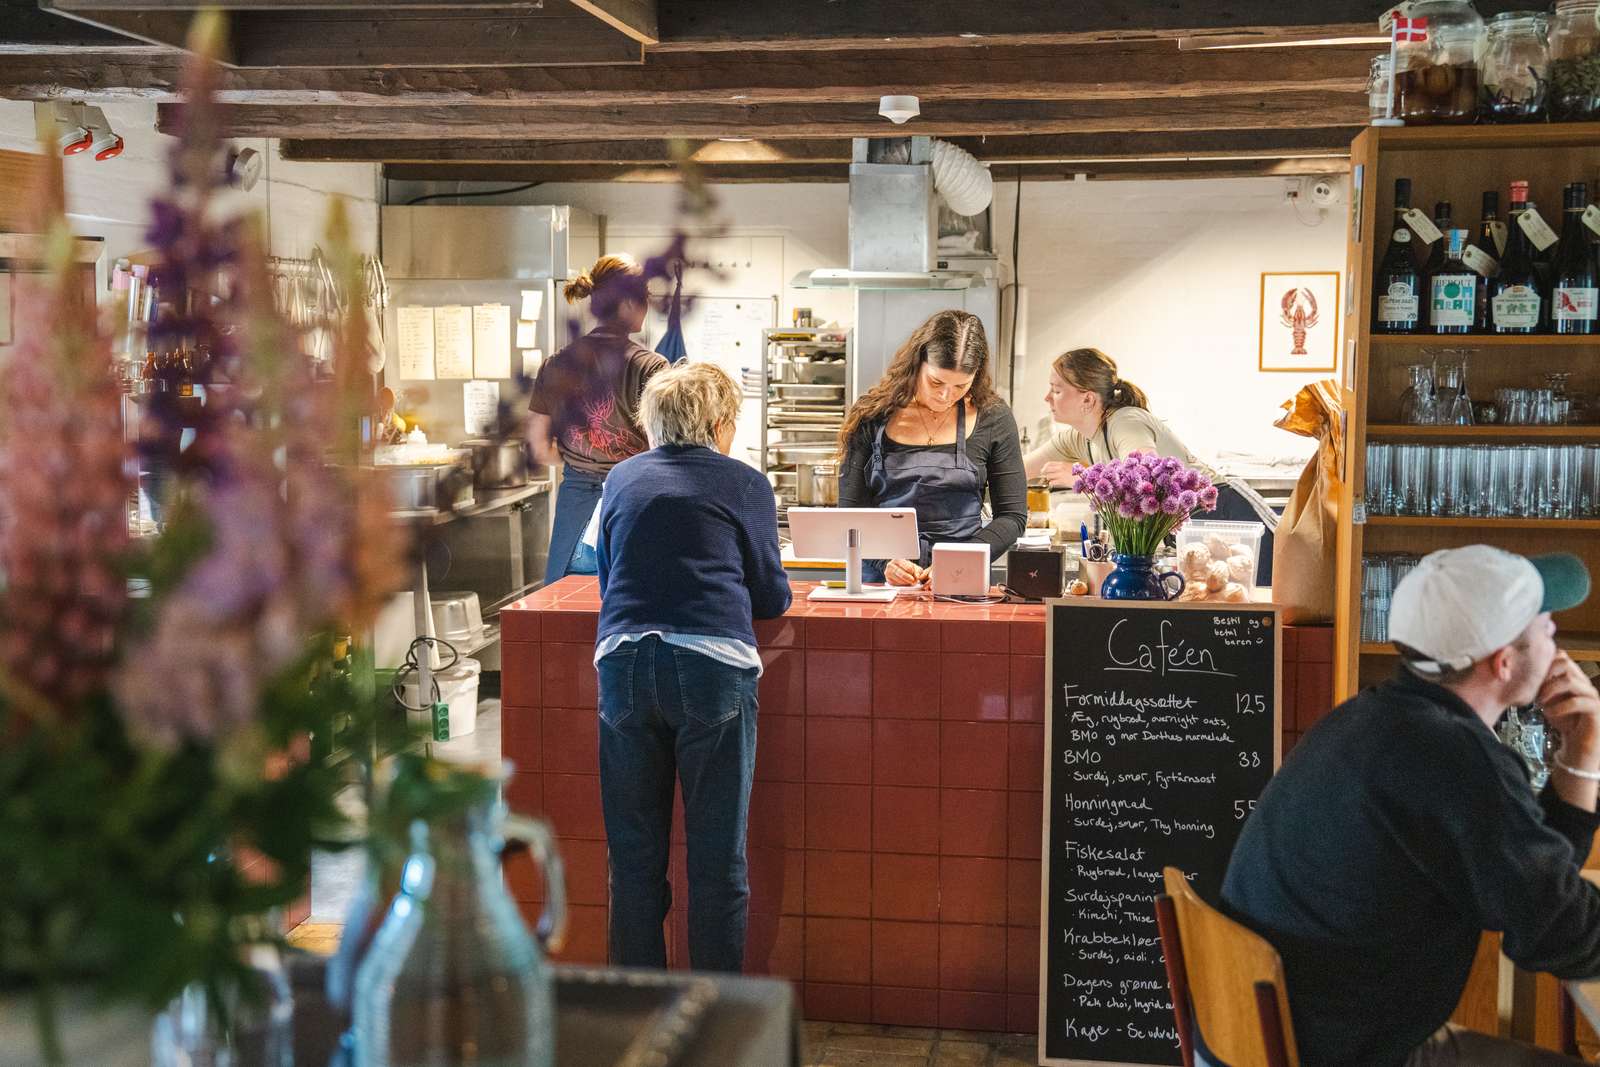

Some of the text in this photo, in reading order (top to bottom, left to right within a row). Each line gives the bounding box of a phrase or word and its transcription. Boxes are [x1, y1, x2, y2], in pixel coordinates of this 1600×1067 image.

[1213, 616, 1260, 629] Bestil og
[1214, 627, 1250, 637] betal i
[1108, 618, 1219, 677] Caféen
[1224, 638, 1252, 646] baren
[1064, 683, 1265, 714] Formiddagssættet 125
[1151, 712, 1199, 729] overnight
[1070, 729, 1098, 742] BMO
[1105, 734, 1116, 746] og
[1064, 749, 1261, 768] BMO 38
[1065, 792, 1153, 816] Honningmad
[1150, 819, 1171, 836] Thy
[1065, 840, 1146, 861] Fiskesalat
[1063, 927, 1163, 947] Krabbekløer
[1063, 973, 1113, 995] Dagens
[1119, 980, 1163, 995] grønne
[1065, 1018, 1110, 1042] Kage
